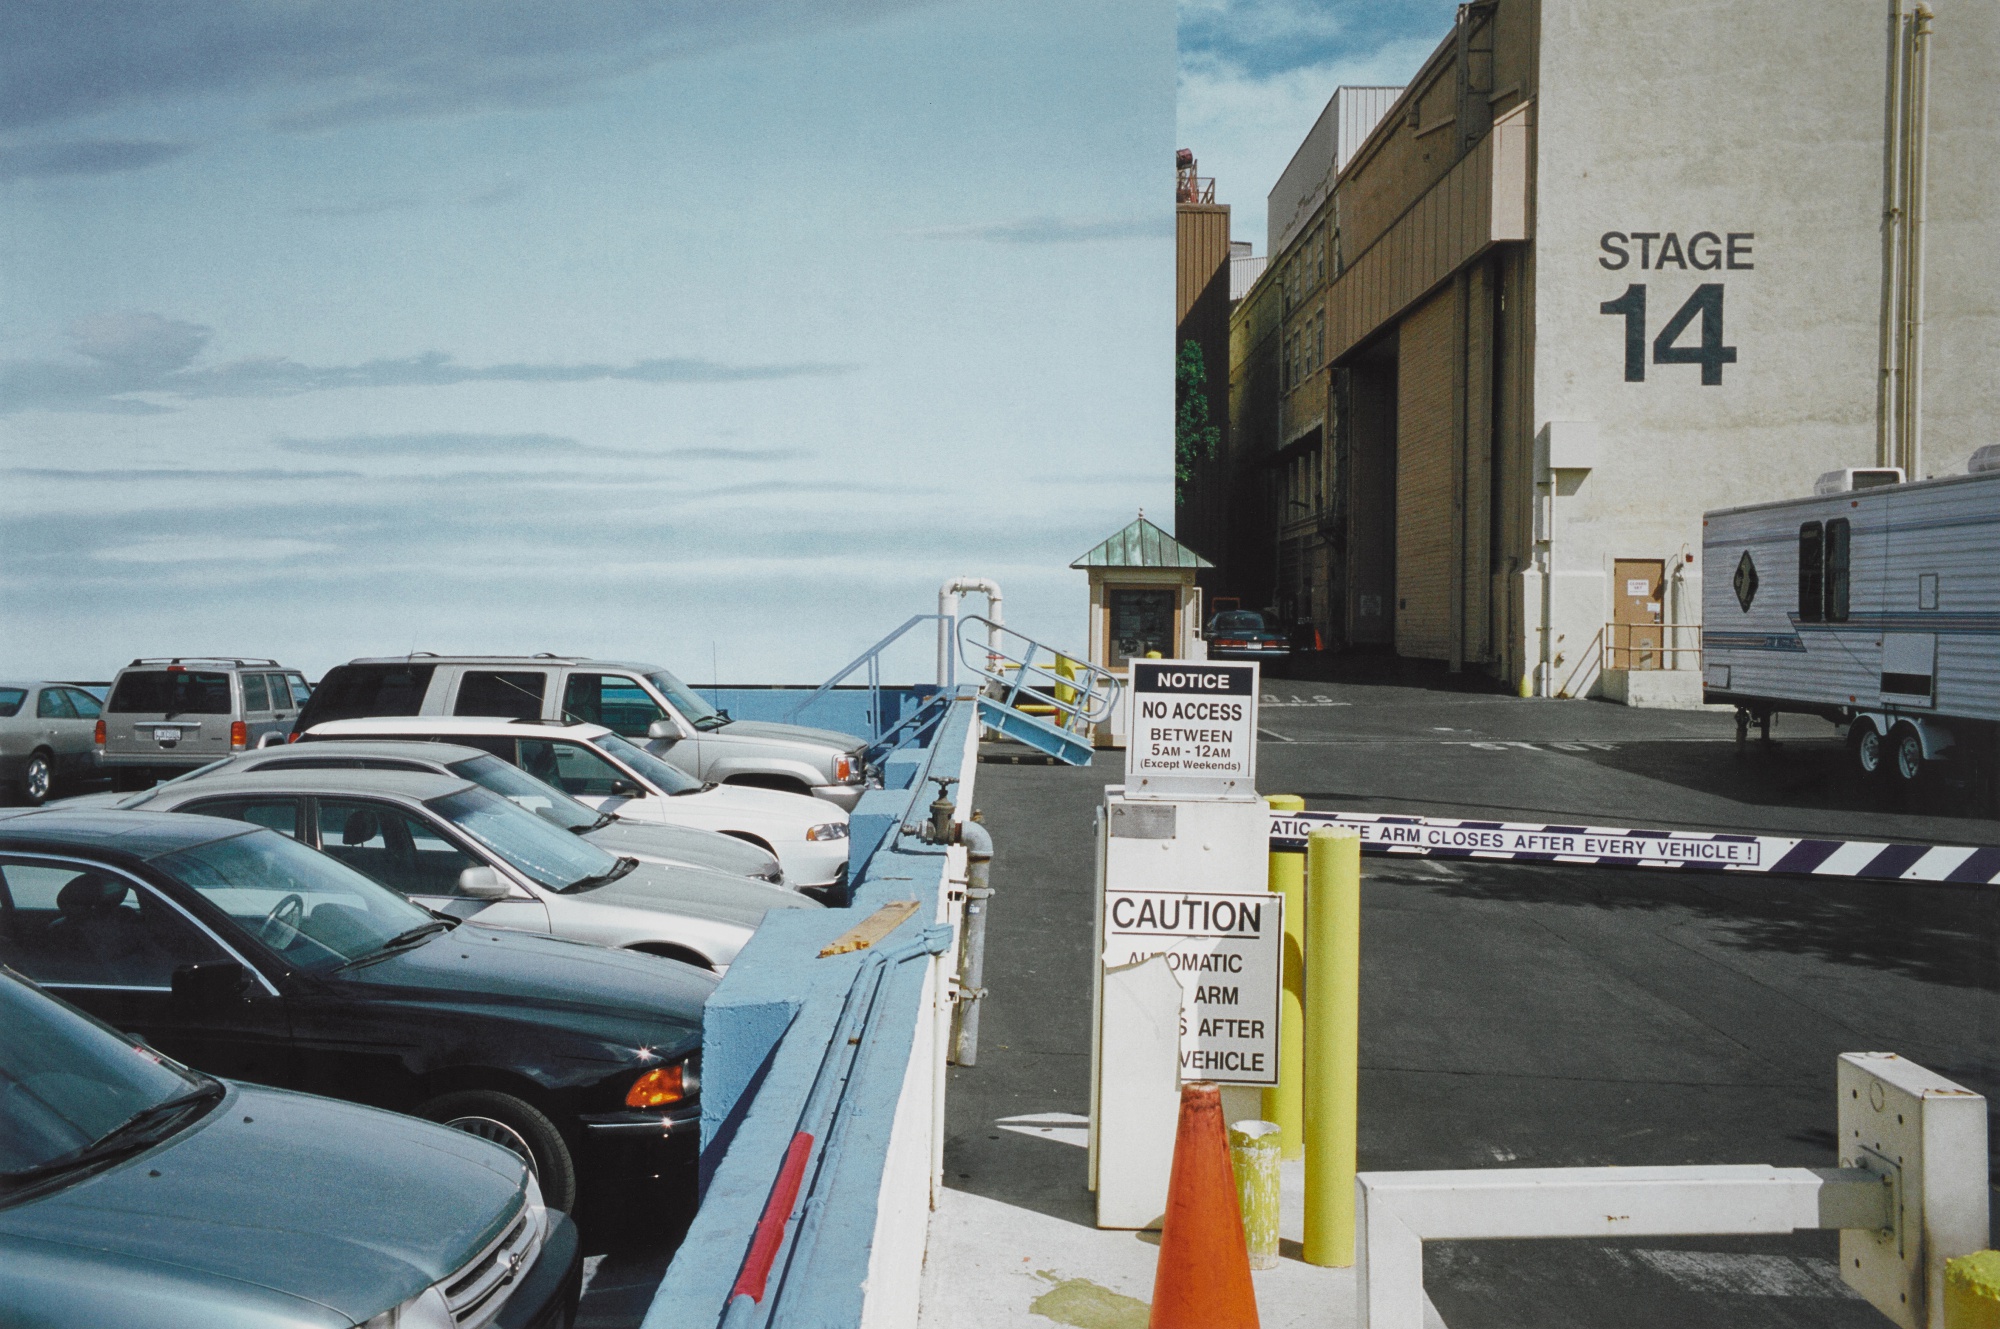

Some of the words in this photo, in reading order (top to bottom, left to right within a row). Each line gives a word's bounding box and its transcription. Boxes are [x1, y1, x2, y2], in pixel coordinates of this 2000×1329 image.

[1598, 231, 1755, 271] STAGE
[1599, 283, 1738, 386] 14
[1157, 672, 1230, 689] NOTICE
[1142, 701, 1168, 719] NO
[1172, 702, 1243, 721] ACCESS
[1150, 727, 1233, 743] BETWEEN
[1151, 743, 1181, 756] 5AM
[1194, 744, 1231, 758] 12AM
[1140, 758, 1180, 770] (Except
[1183, 759, 1241, 771] Weekends)
[1269, 820, 1311, 836] ATIC
[1380, 826, 1421, 843] ARM
[1428, 830, 1504, 848] CLOSES
[1514, 835, 1575, 852] AFTER
[1585, 838, 1647, 855] EVERY
[1657, 841, 1739, 860] VEHICLE
[1112, 897, 1262, 933] CAUTION
[1129, 951, 1243, 974] AOMATIC
[1193, 985, 1239, 1005] ARM
[1198, 1018, 1265, 1039] AFTER
[1181, 1050, 1265, 1072] VEHICLE
